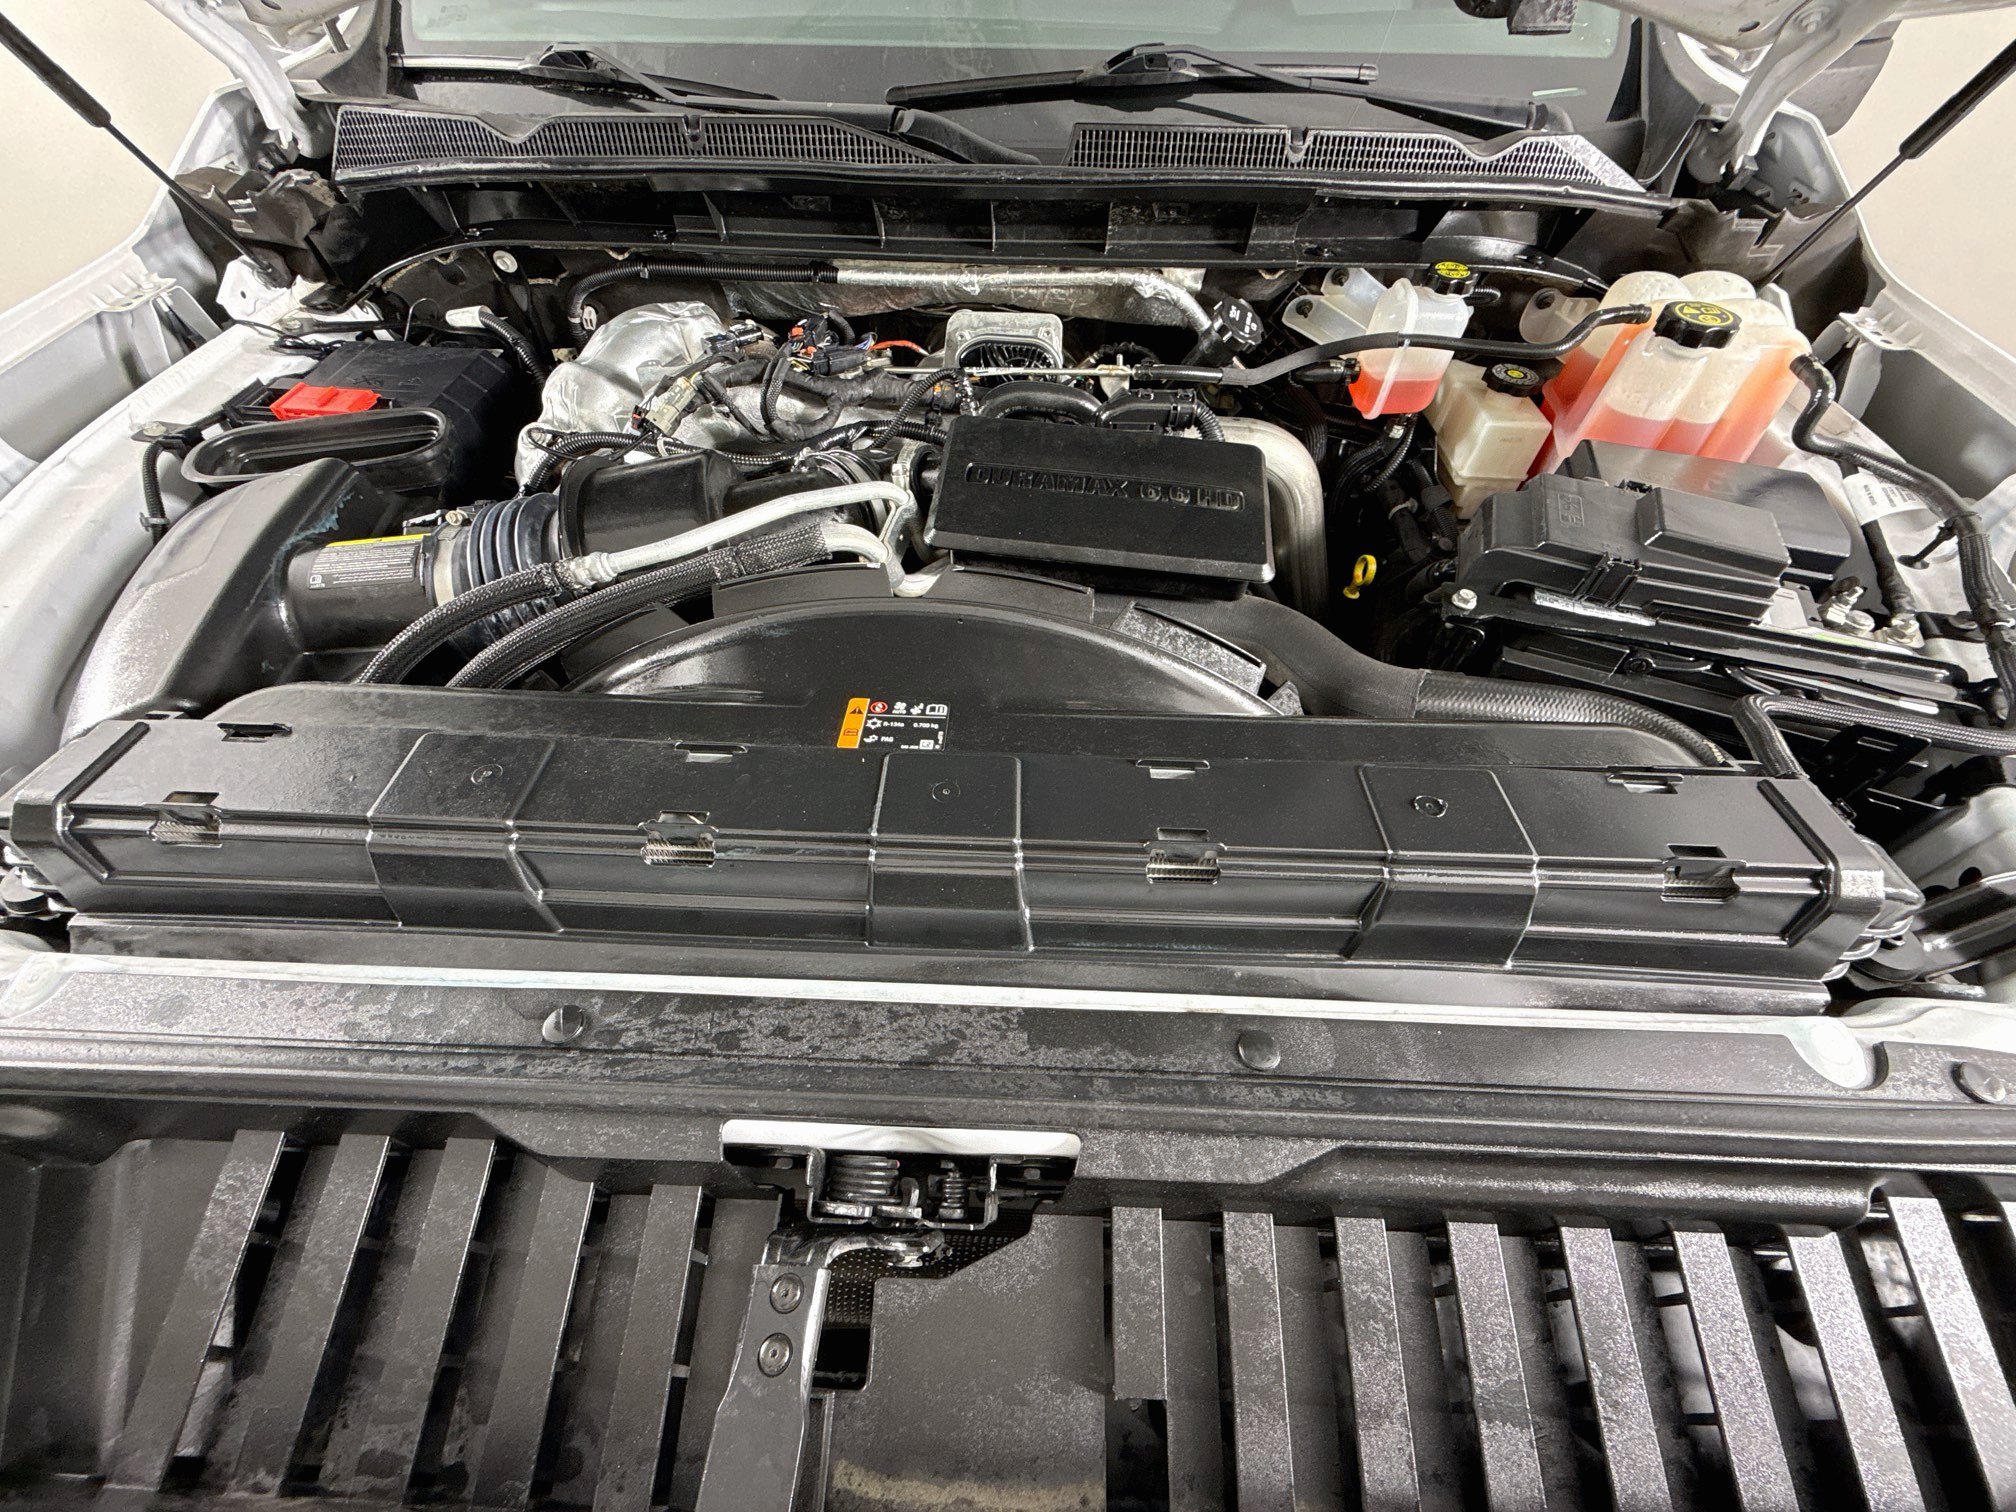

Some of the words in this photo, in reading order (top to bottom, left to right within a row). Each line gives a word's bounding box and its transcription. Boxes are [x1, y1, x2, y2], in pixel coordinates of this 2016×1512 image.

[971, 465, 1129, 498] DURAMAX
[1140, 482, 1190, 505] 6.6
[1196, 486, 1243, 511] HD
